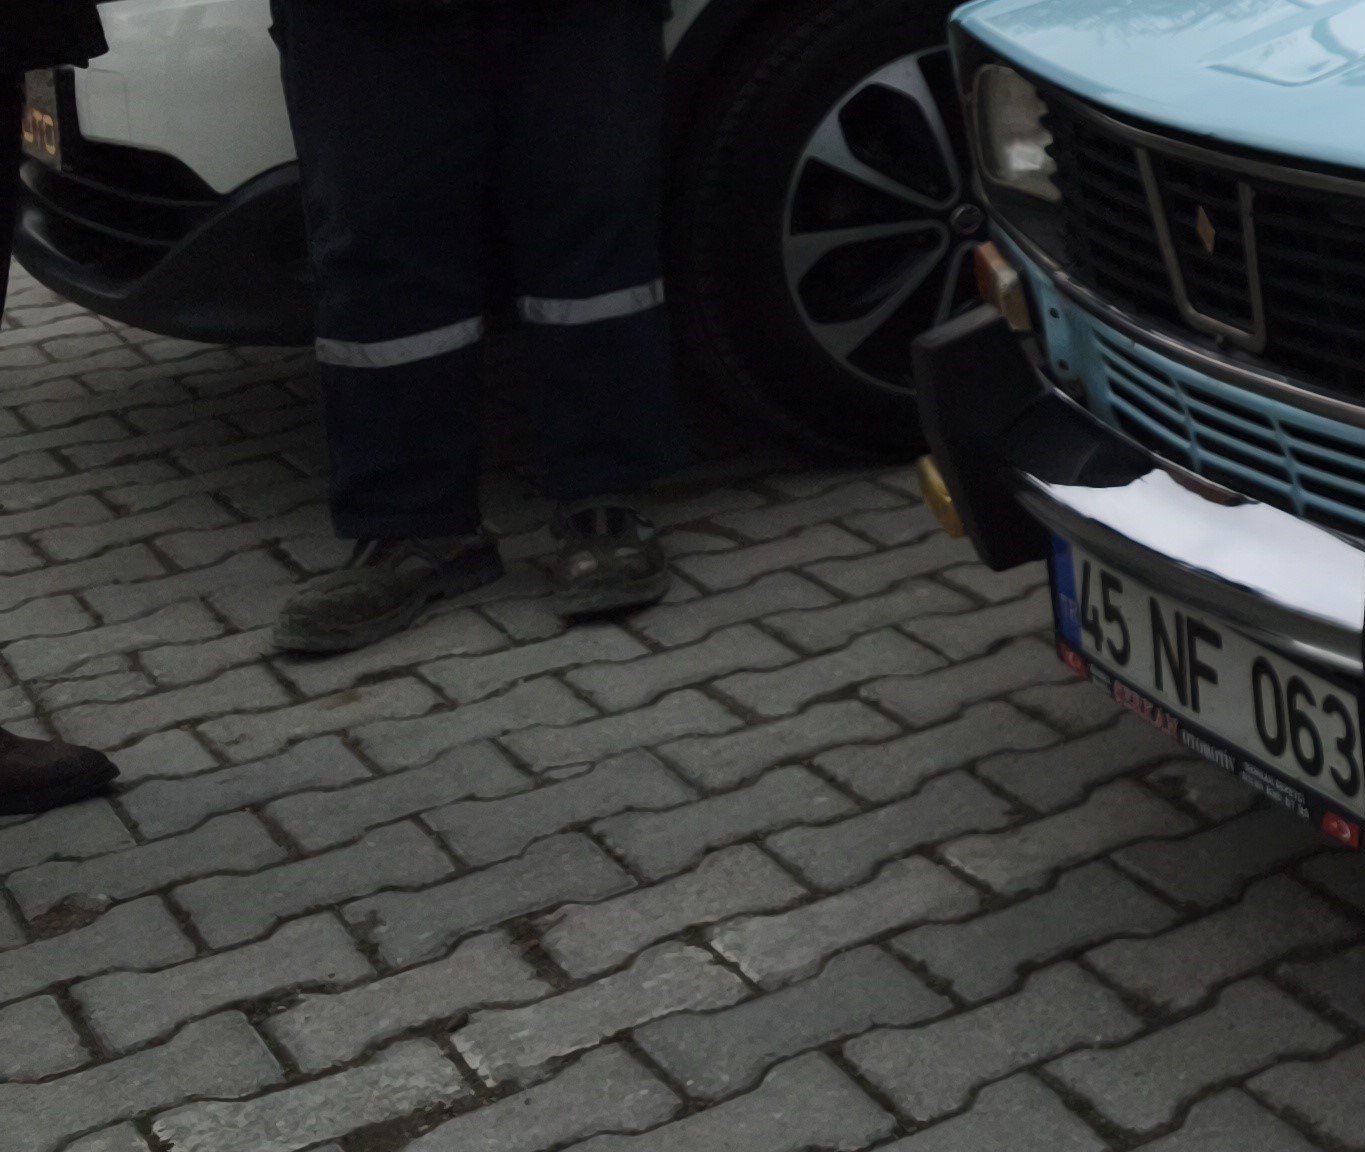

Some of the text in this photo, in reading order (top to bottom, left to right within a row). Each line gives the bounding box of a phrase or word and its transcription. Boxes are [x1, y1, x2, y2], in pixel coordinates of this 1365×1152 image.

[1080, 559, 1131, 666] 45
[1149, 596, 1223, 713] NF
[1250, 654, 1361, 798] 063
